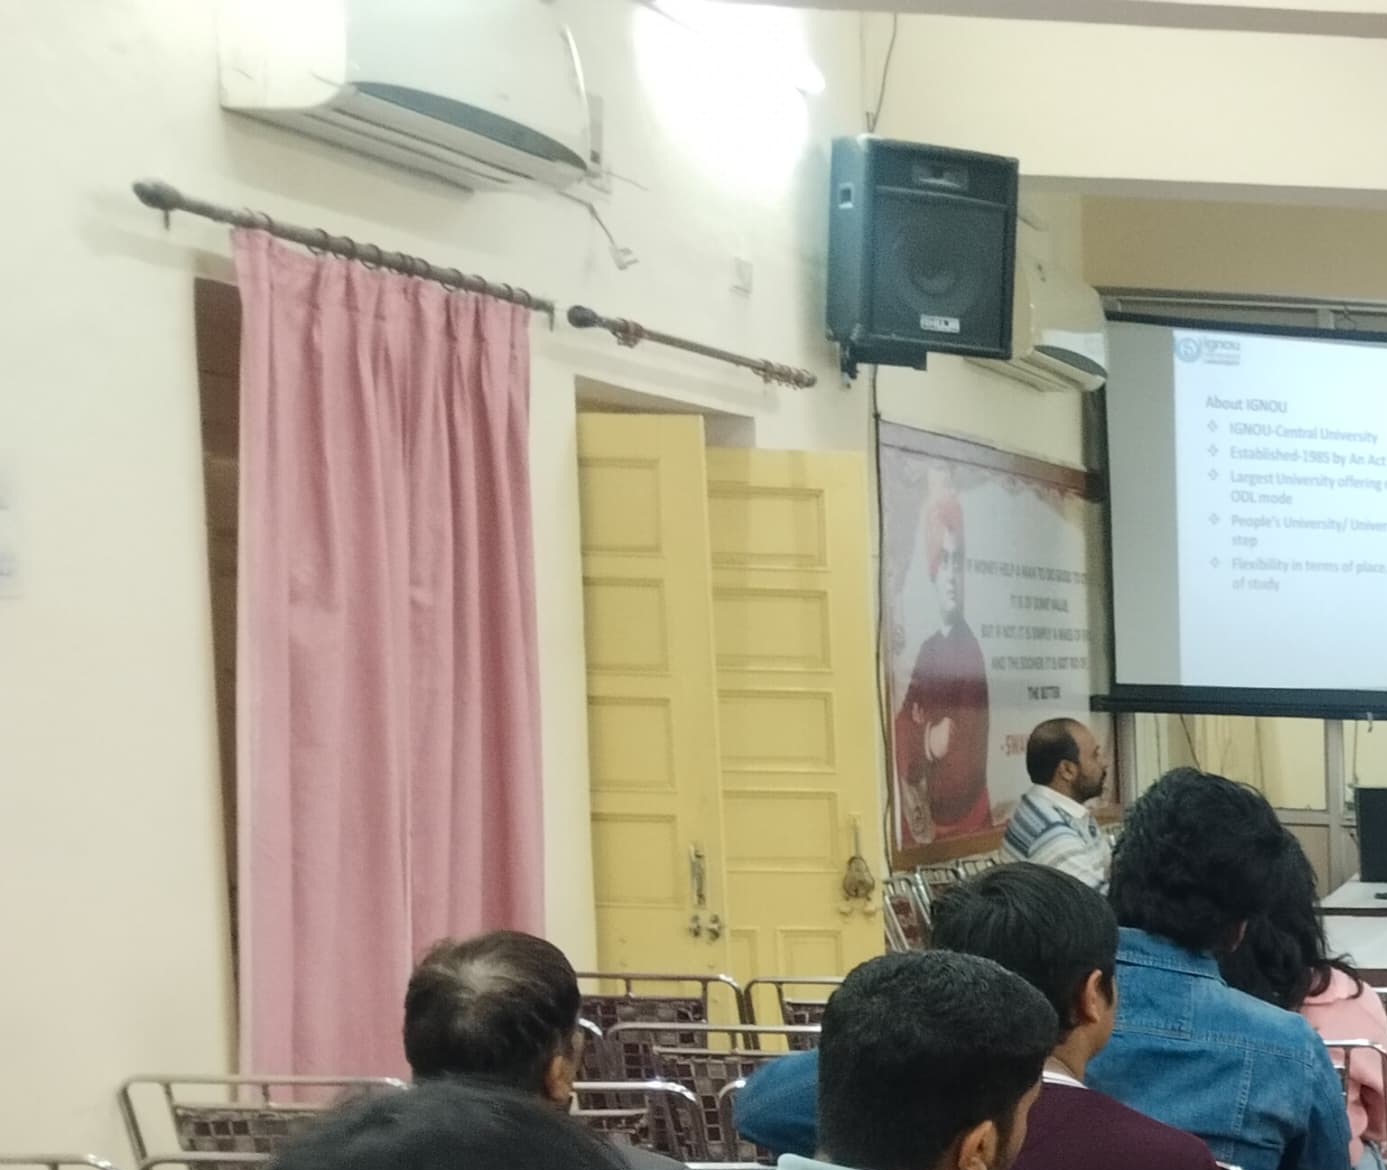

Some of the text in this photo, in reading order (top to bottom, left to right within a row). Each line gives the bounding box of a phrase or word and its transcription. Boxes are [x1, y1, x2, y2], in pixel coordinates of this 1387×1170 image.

[1205, 395, 1288, 413] About IGNOU
[1320, 427, 1378, 445] University
[1332, 451, 1347, 467] by
[1348, 453, 1365, 465] An
[1368, 454, 1386, 467] Act
[1230, 470, 1274, 487] Largest
[1275, 472, 1336, 488] University
[1337, 475, 1382, 492] offering
[1258, 492, 1294, 505] mode
[1231, 535, 1258, 548] step
[1231, 557, 1289, 573] Flexibility
[1304, 560, 1339, 573] terms
[1340, 559, 1354, 573] of
[1231, 575, 1281, 592] of study
